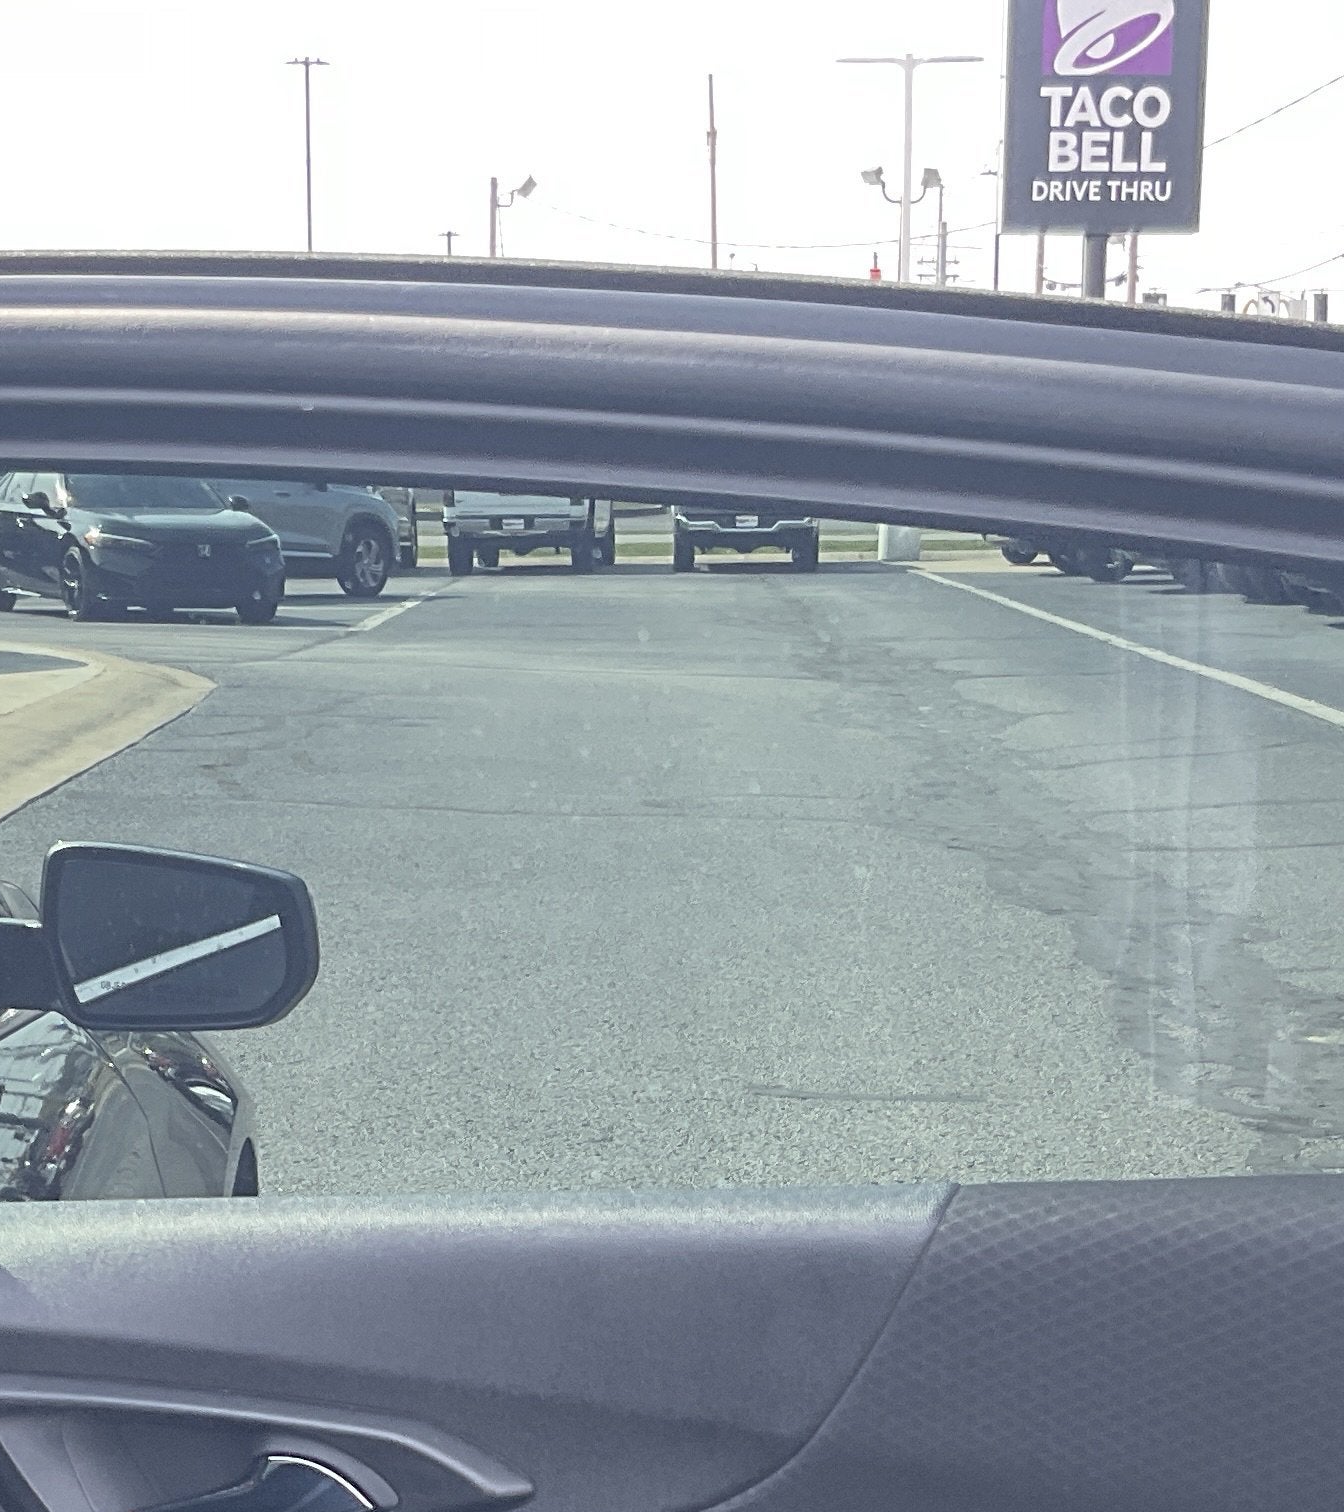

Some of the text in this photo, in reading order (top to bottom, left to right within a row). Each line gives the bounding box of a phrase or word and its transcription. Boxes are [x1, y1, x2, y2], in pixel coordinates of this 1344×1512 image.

[1040, 86, 1171, 128] TACO
[1048, 131, 1166, 173] BELL
[1032, 180, 1172, 202] DRIVE THRU
